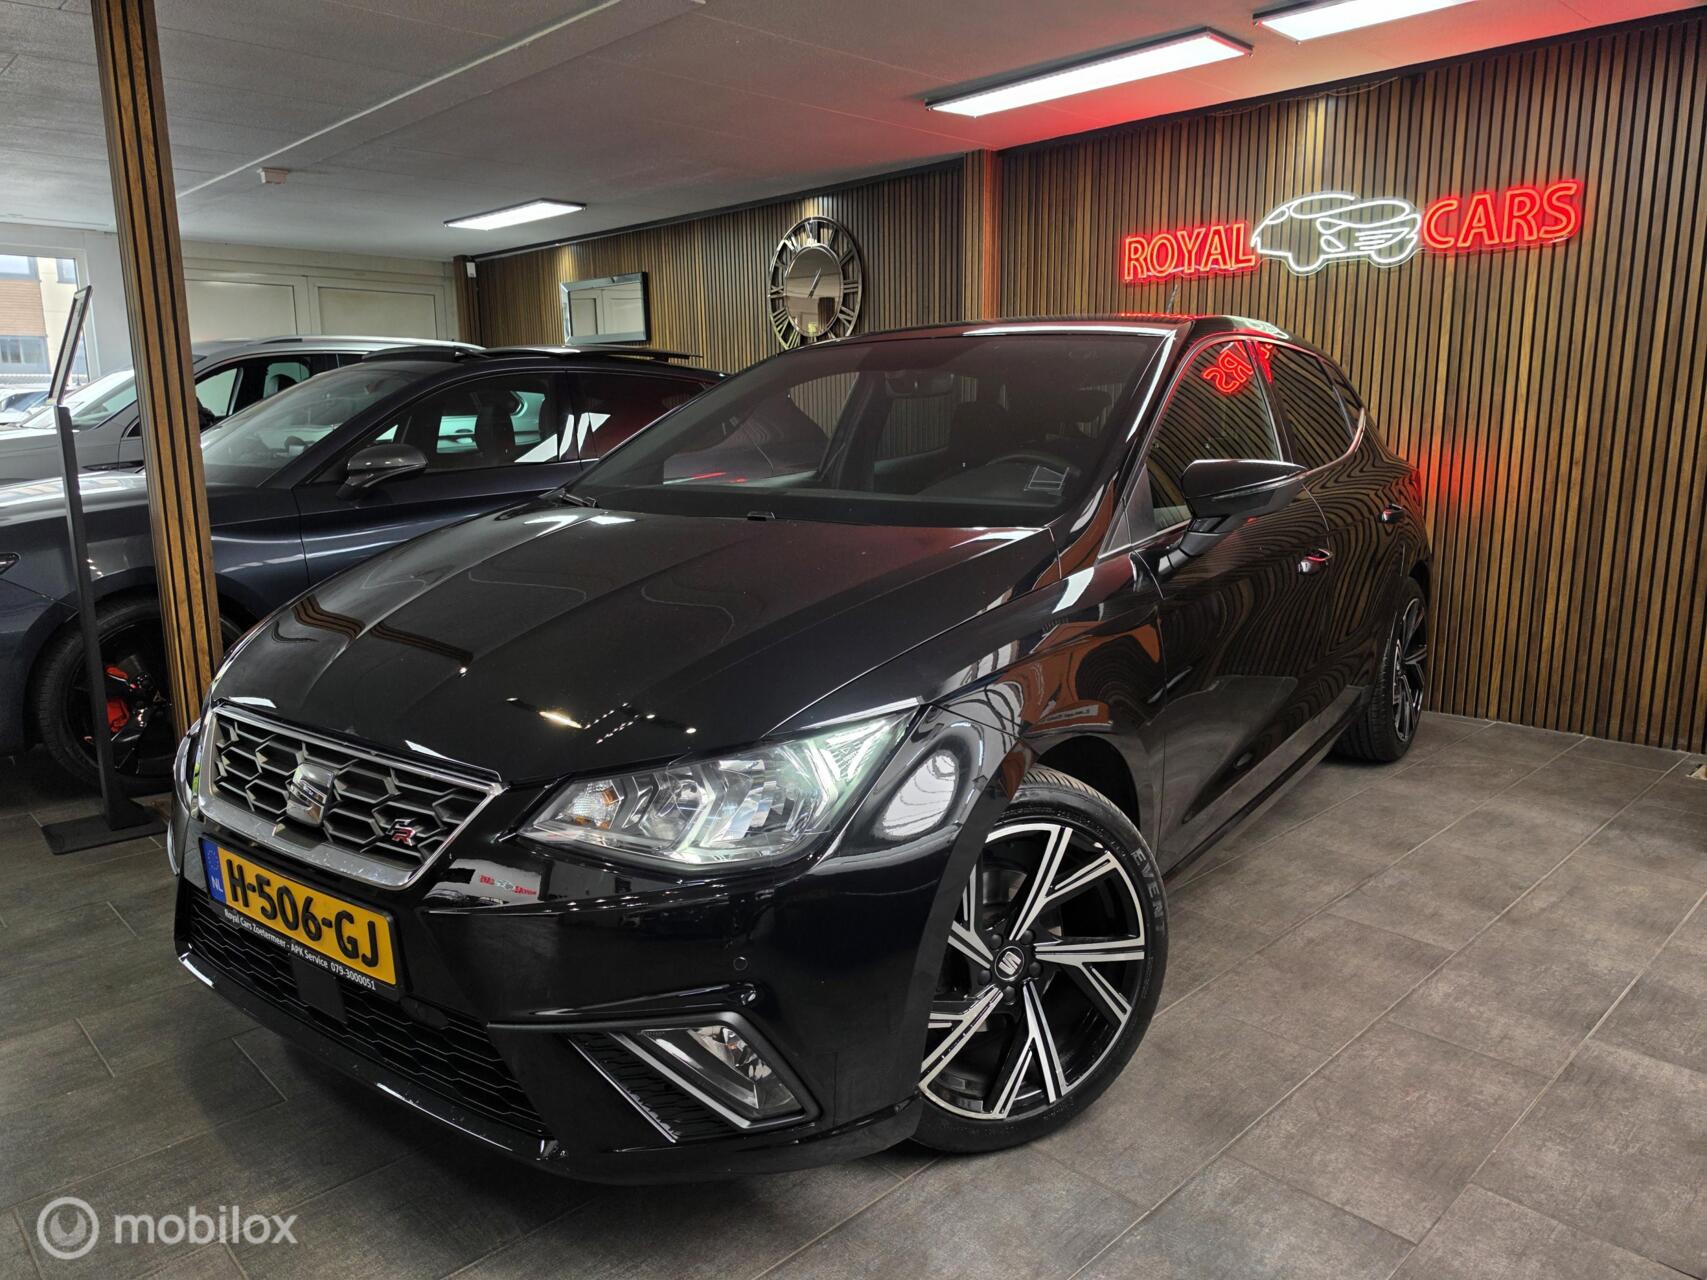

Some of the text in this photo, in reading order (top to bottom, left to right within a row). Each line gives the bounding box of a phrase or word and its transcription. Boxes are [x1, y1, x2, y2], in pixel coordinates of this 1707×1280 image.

[1122, 180, 1579, 281] ROYAL CARS
[211, 875, 224, 893] NL
[226, 858, 379, 968] H-506-GJ
[224, 908, 240, 925] Royal
[239, 917, 253, 931] Cars
[291, 943, 304, 959] APK
[304, 950, 329, 969] Service
